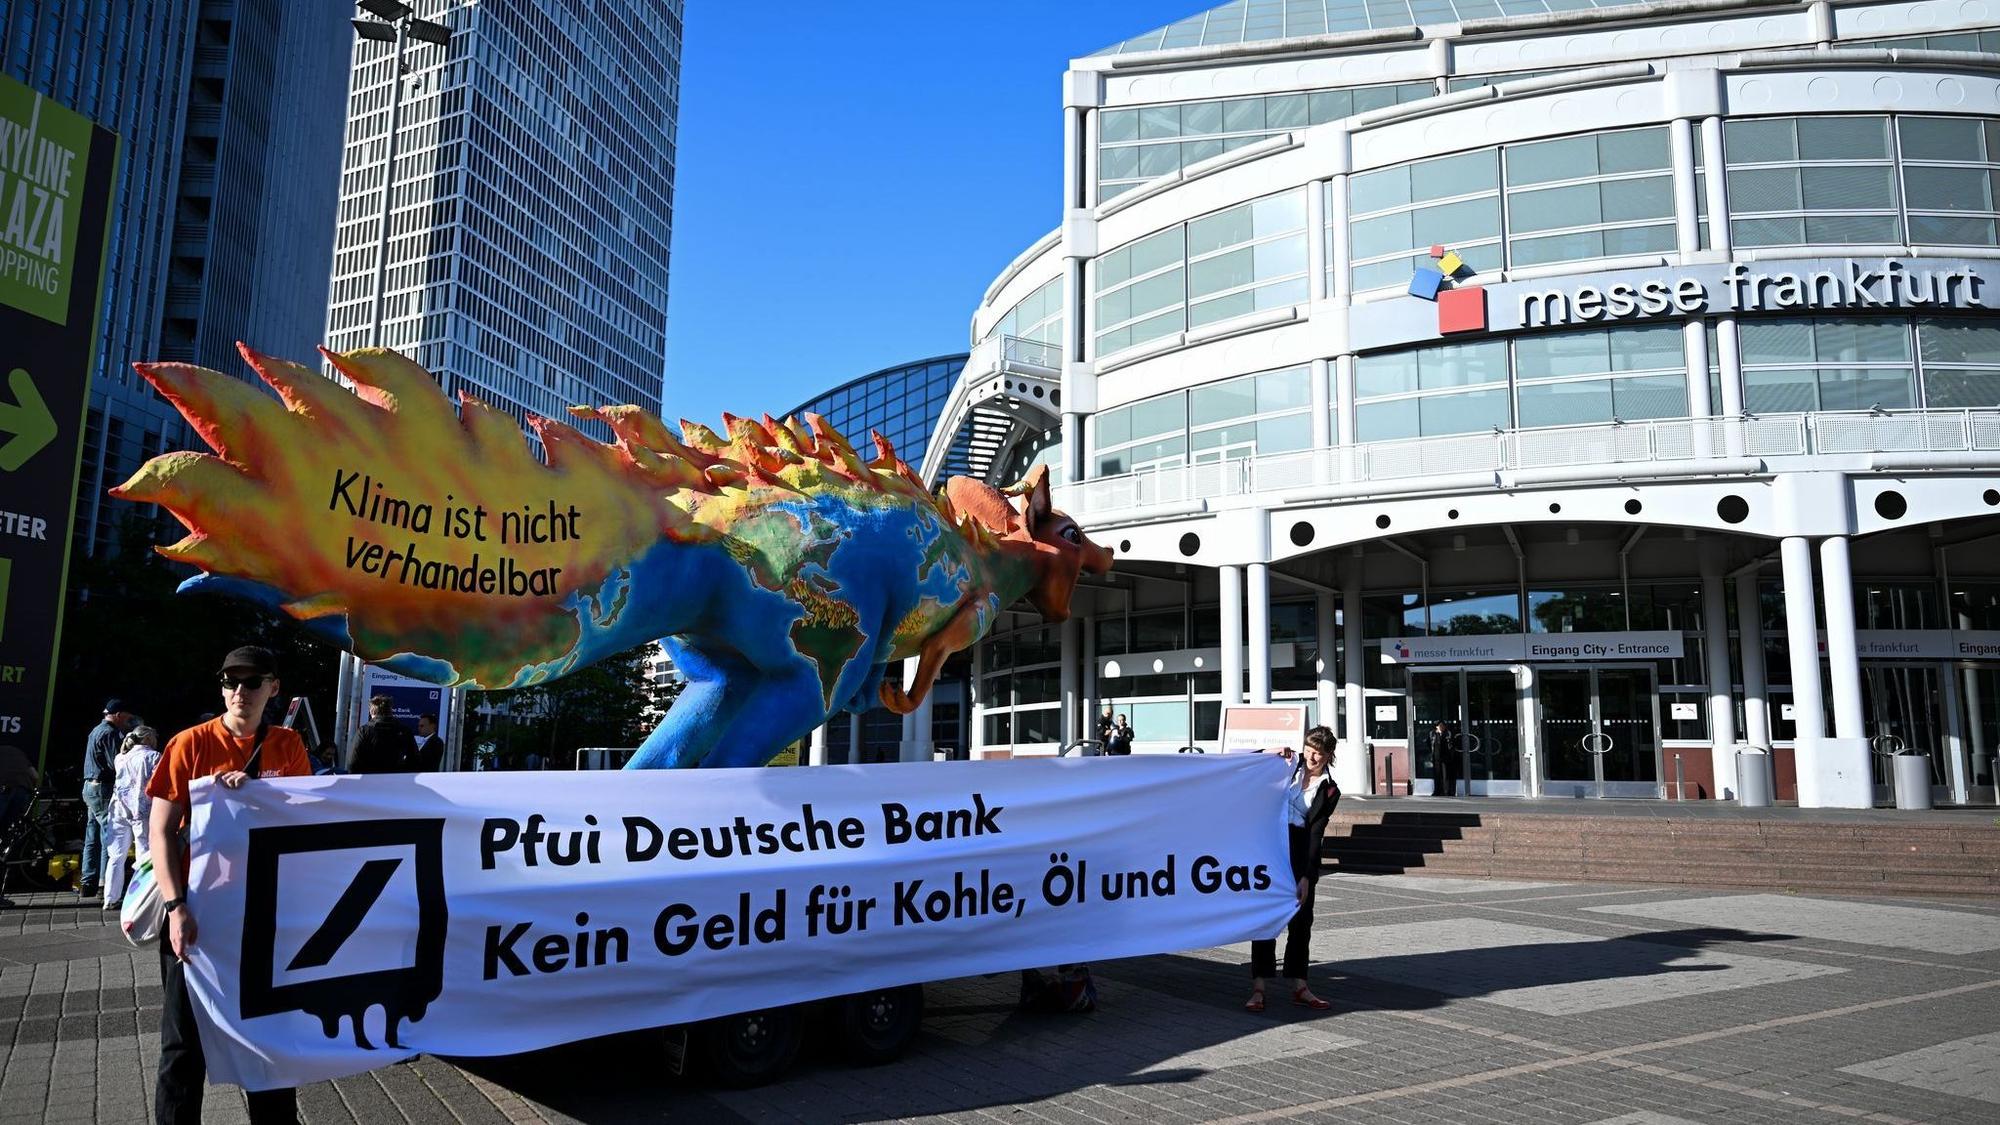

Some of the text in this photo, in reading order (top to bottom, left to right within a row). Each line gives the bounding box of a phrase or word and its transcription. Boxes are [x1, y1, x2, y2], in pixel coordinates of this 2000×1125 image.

[1518, 257, 1981, 326] messe frankfurt
[0, 511, 47, 540] TER
[329, 468, 581, 544] Klima ist nicht
[346, 537, 562, 596] verhandelbar
[1414, 647, 1494, 658] messe frankfurt
[1532, 645, 1580, 656] Eingang
[1583, 644, 1607, 656] City
[1618, 643, 1670, 654] Entrance
[1870, 642, 1919, 653] frankfurt
[480, 793, 1004, 870] Pfui Deutsche Bank
[483, 852, 1272, 980] Kein Geld für Kohle, Öl und Gas
